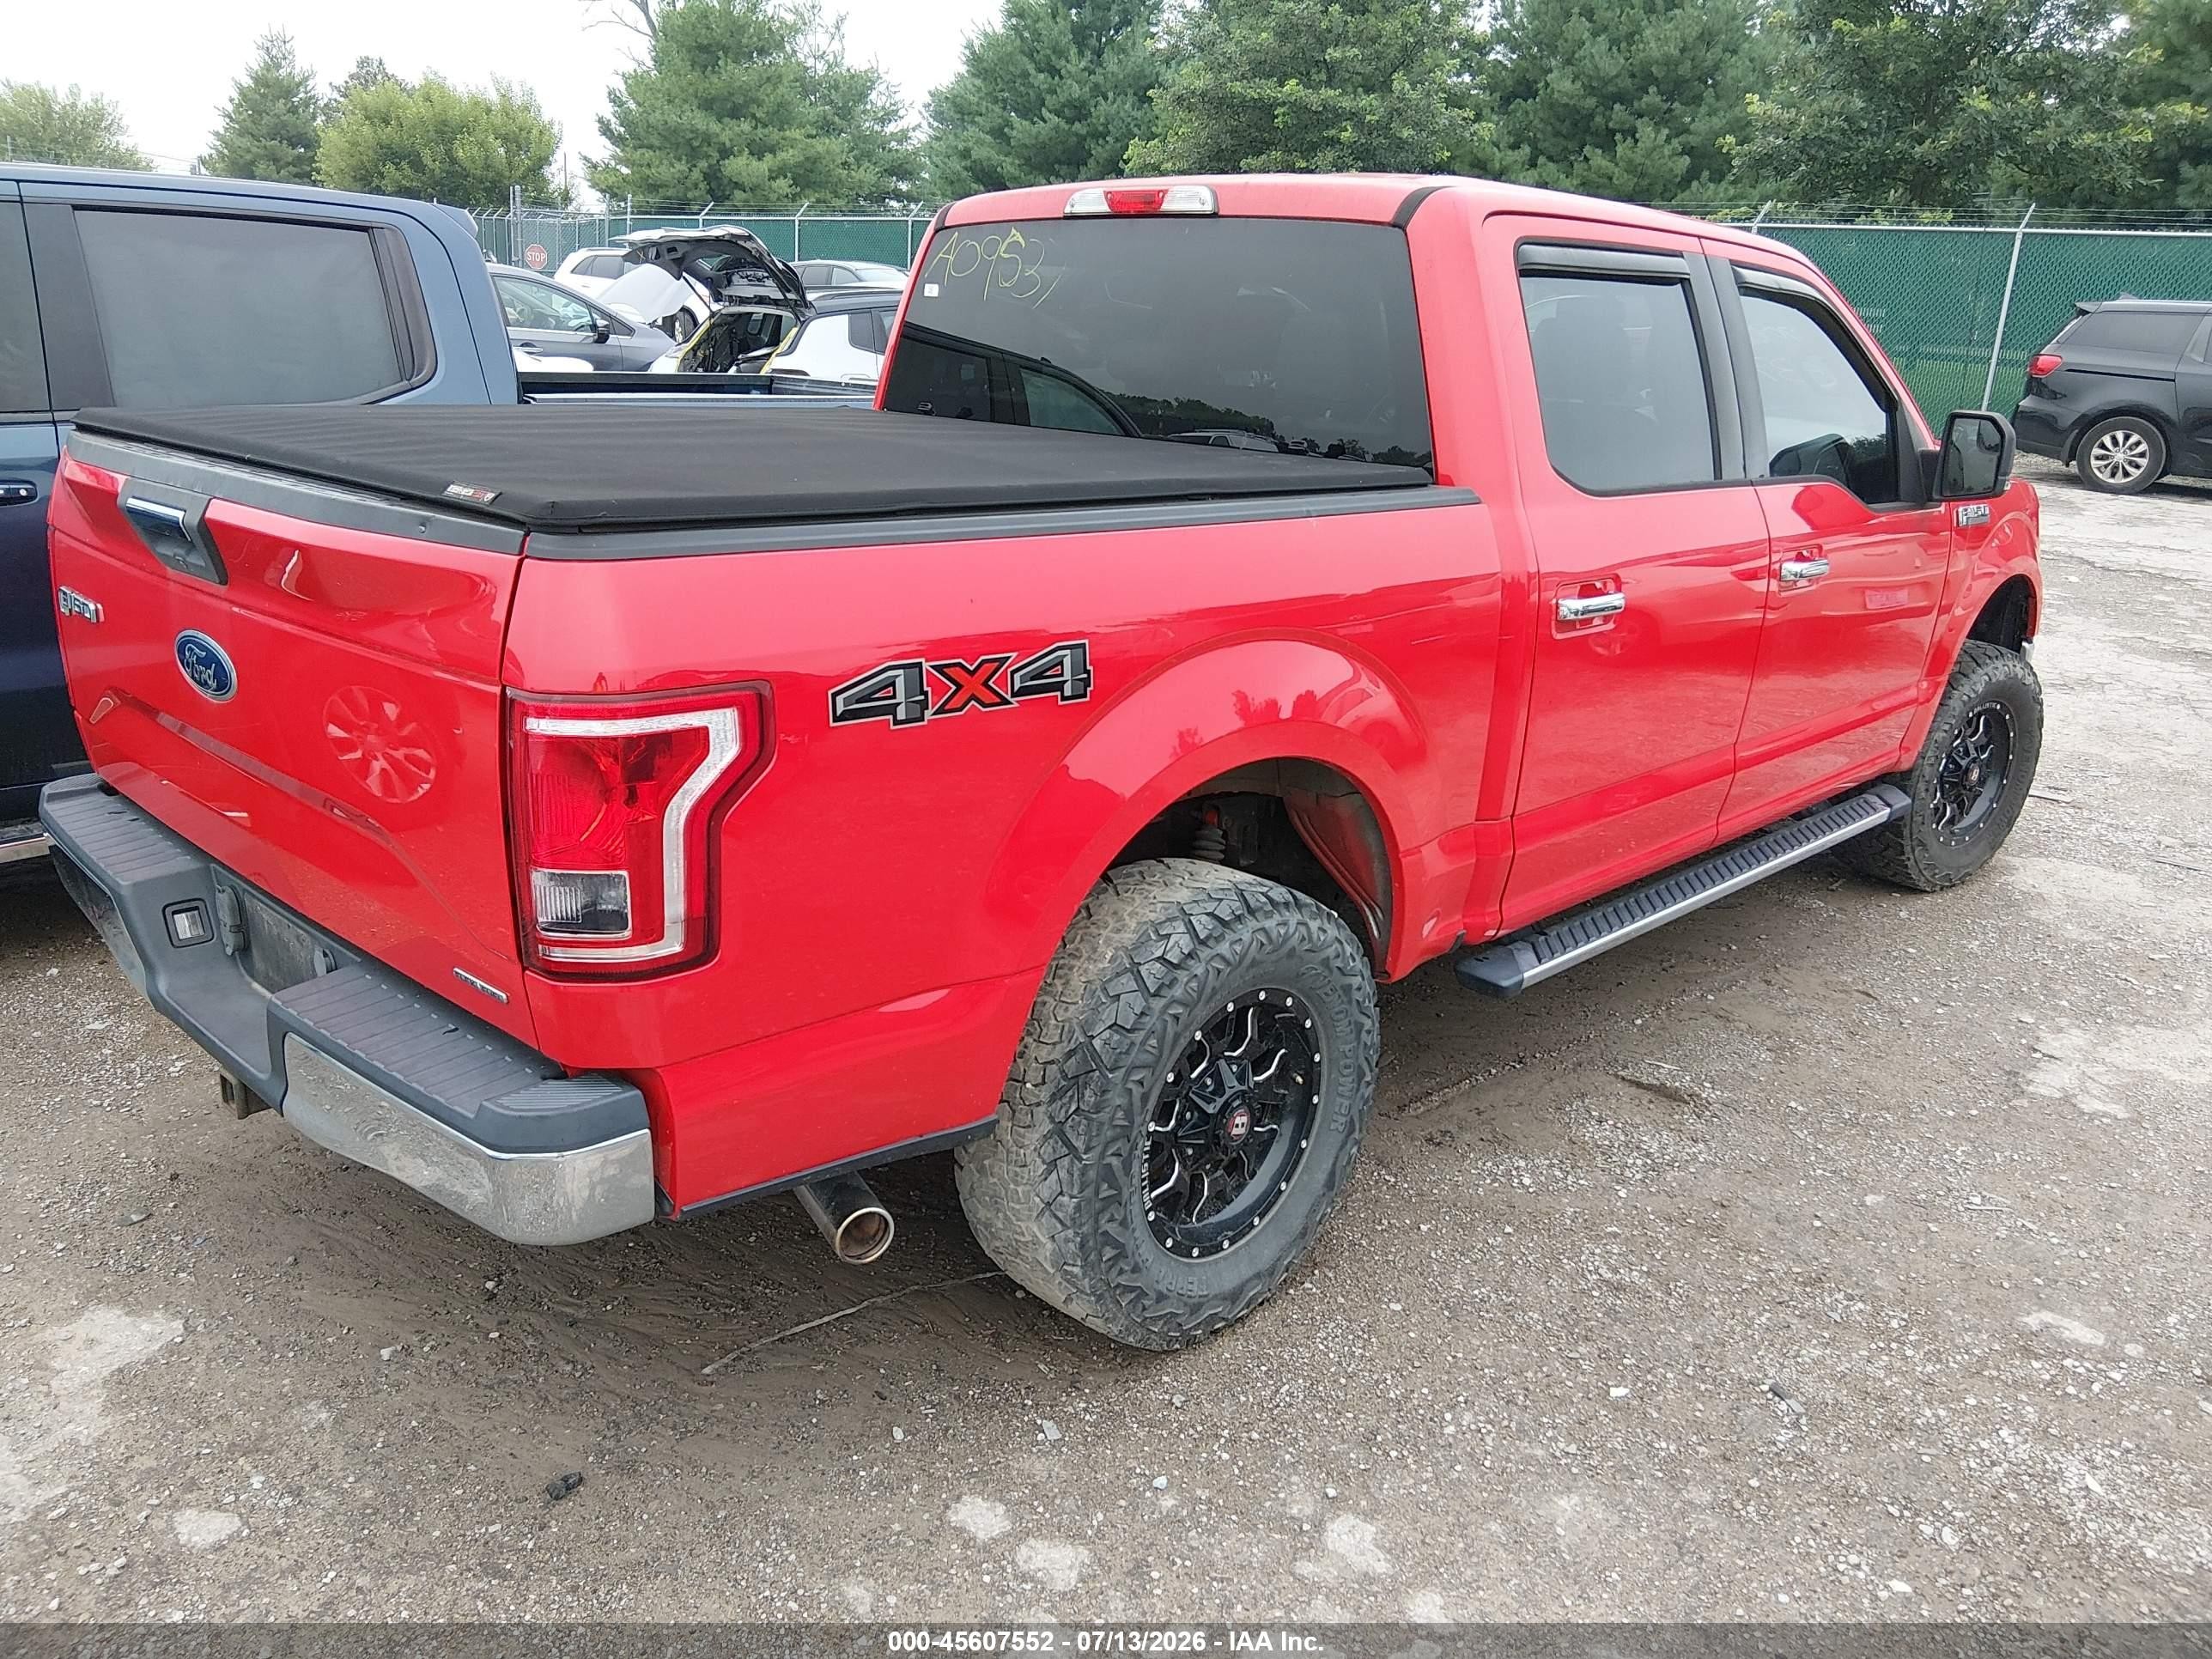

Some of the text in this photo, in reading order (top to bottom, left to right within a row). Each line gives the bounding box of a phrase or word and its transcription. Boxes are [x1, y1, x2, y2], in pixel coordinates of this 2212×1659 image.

[526, 252, 546, 262] STOP
[184, 643, 218, 690] Ford
[1330, 1044, 1357, 1133] POWER
[1141, 1135, 1153, 1212] BALLISTIC
